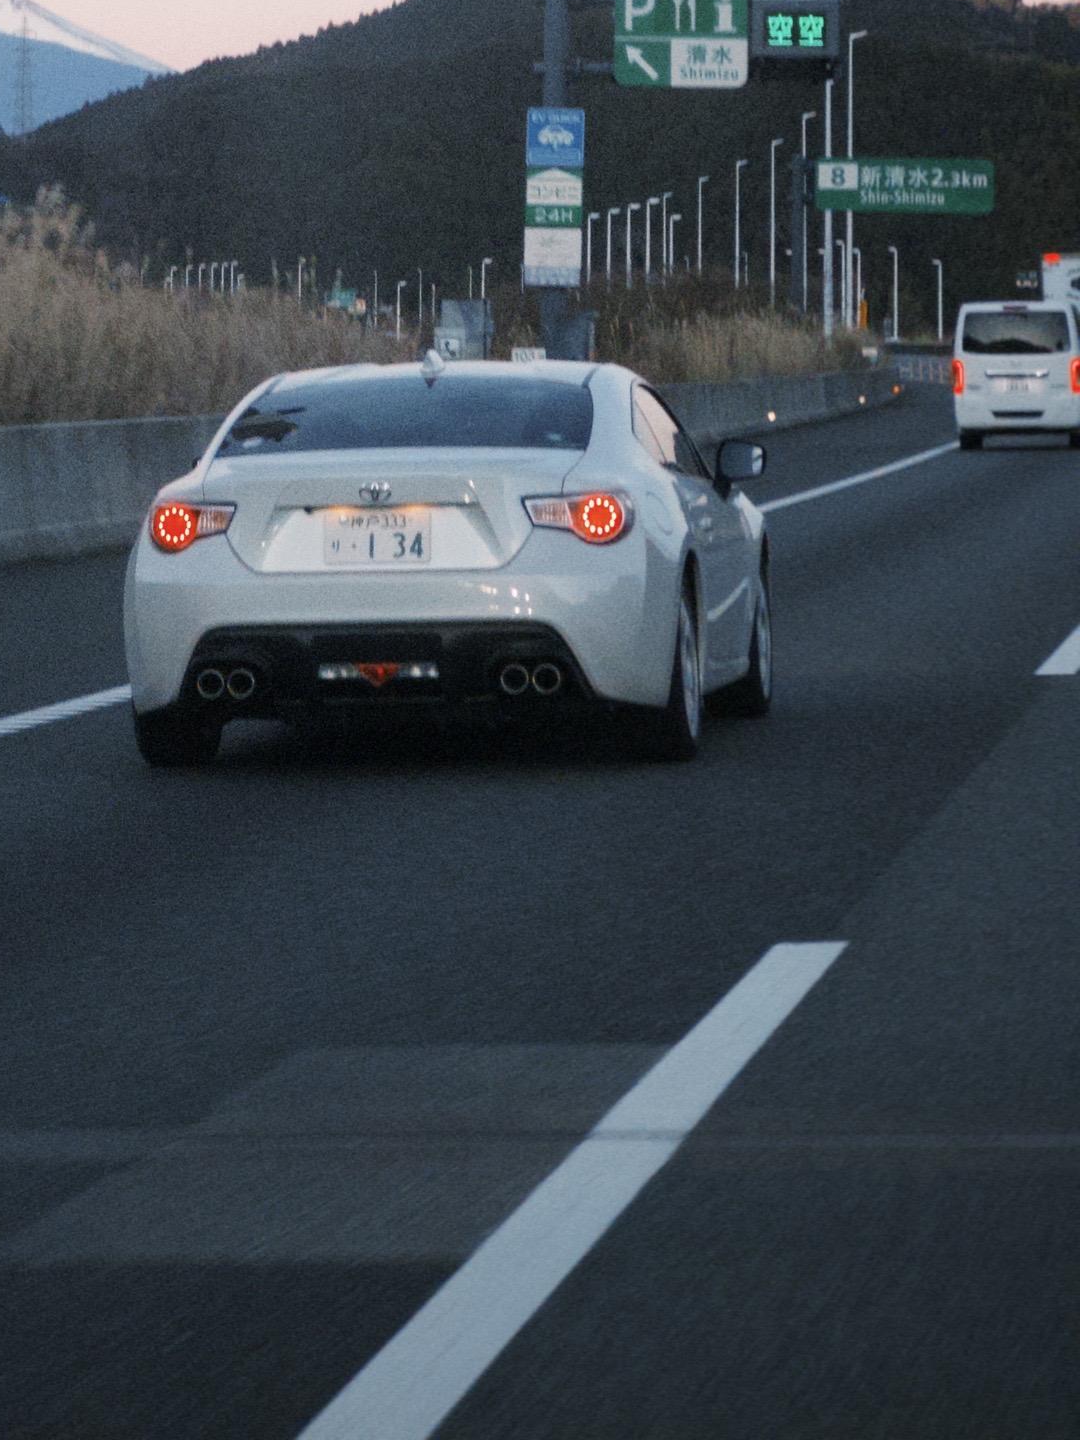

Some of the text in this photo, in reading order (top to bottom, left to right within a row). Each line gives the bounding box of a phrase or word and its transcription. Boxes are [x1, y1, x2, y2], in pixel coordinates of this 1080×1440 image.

[687, 44, 732, 65] 清水
[680, 67, 739, 81] Shimizu
[831, 166, 846, 187] 8
[860, 190, 945, 205] Shin-Shimizu
[535, 208, 573, 224] 24H
